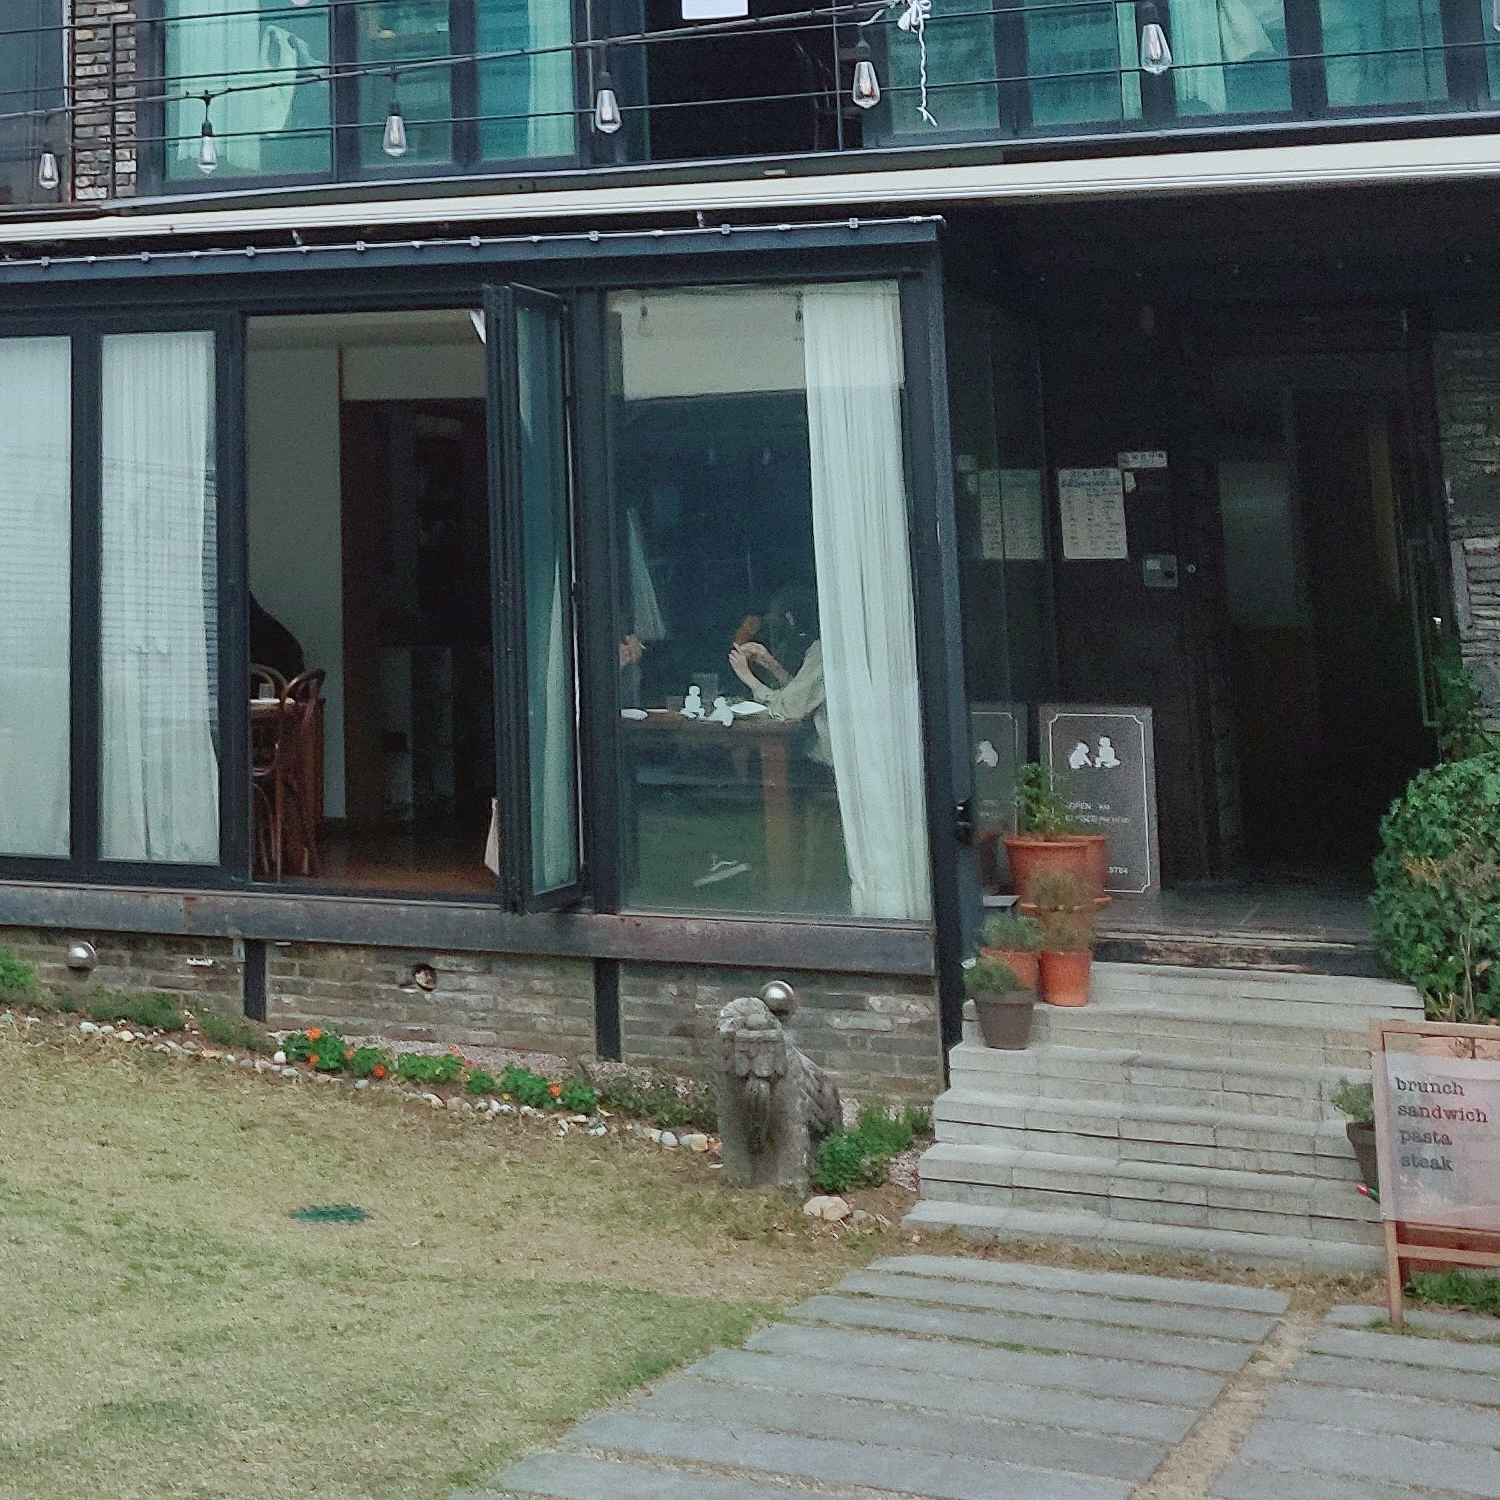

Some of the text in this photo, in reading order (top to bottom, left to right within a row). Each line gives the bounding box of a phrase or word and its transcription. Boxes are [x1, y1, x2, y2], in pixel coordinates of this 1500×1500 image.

[1395, 1076, 1465, 1097] brunch
[1397, 1105, 1488, 1124] sandwich
[1399, 1130, 1453, 1146] pasta
[1400, 1154, 1454, 1172] steak
